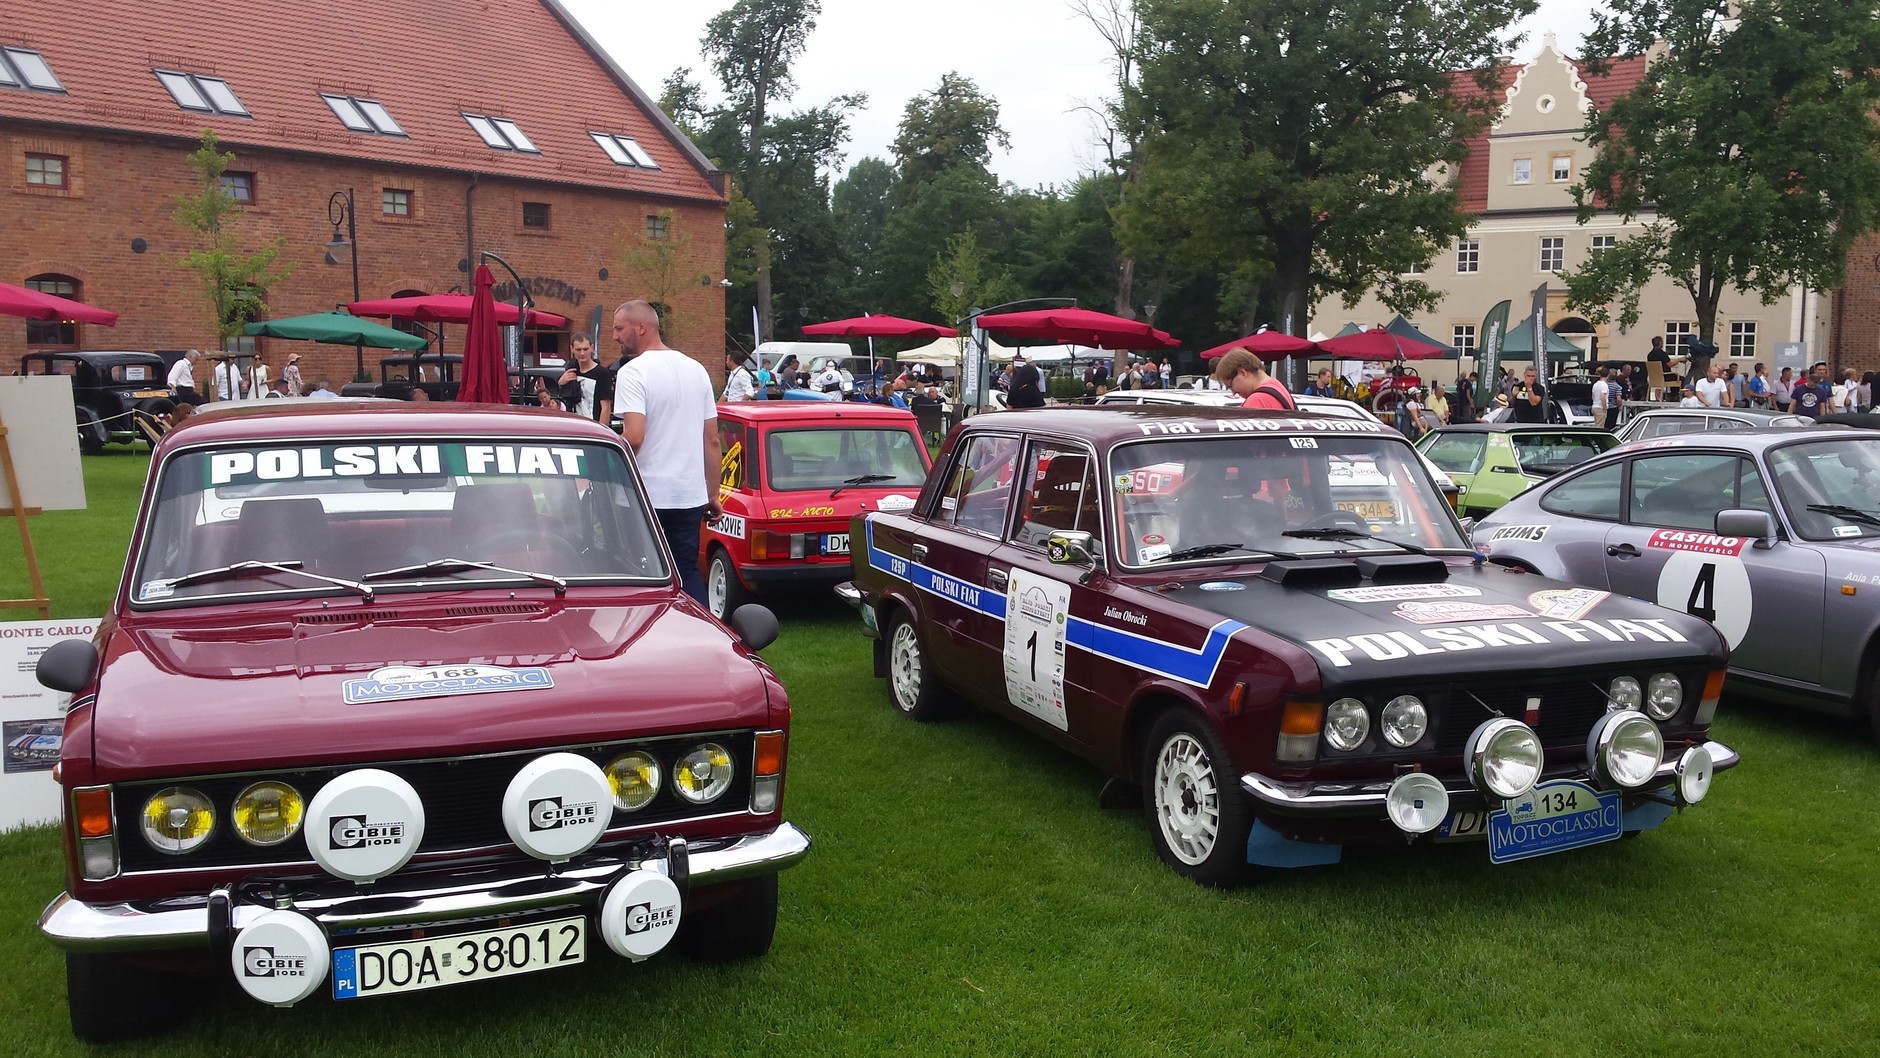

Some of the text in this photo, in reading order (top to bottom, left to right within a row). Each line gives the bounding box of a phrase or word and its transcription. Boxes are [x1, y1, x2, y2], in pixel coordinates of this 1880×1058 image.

[1216, 418, 1280, 432] Auto
[1287, 418, 1381, 433] Poland
[1294, 438, 1314, 448] 125
[210, 445, 585, 485] POLSKI FIAT
[801, 507, 834, 517] AUTO
[1492, 526, 1547, 540] REIMS
[1658, 531, 1739, 547] CASINO
[1669, 543, 1733, 555] MONTE-CARLO
[891, 558, 906, 576] 125P
[1844, 572, 1867, 583] Ania
[931, 574, 980, 606] POLSKI FIAT
[1687, 563, 1716, 624] 4
[1103, 606, 1148, 626] Julian Obrocki
[47, 626, 93, 636] CARLO
[1306, 618, 1689, 667] POLSKI FIAT
[1027, 630, 1037, 682] 1
[426, 668, 479, 679] 168
[356, 673, 540, 697] MOTOCLASSIC
[1541, 790, 1578, 814] 134
[542, 806, 594, 820] CIBIE
[564, 817, 595, 826] IODE
[1497, 804, 1615, 849] MOTOCLASSIC
[344, 827, 401, 838] CIBIE
[1439, 825, 1449, 833] PL
[367, 838, 402, 846] IODE
[635, 909, 673, 924] CIBIE
[651, 919, 674, 928] IODE
[256, 959, 304, 968] CIBIE
[338, 924, 580, 991] PL DOA 38012
